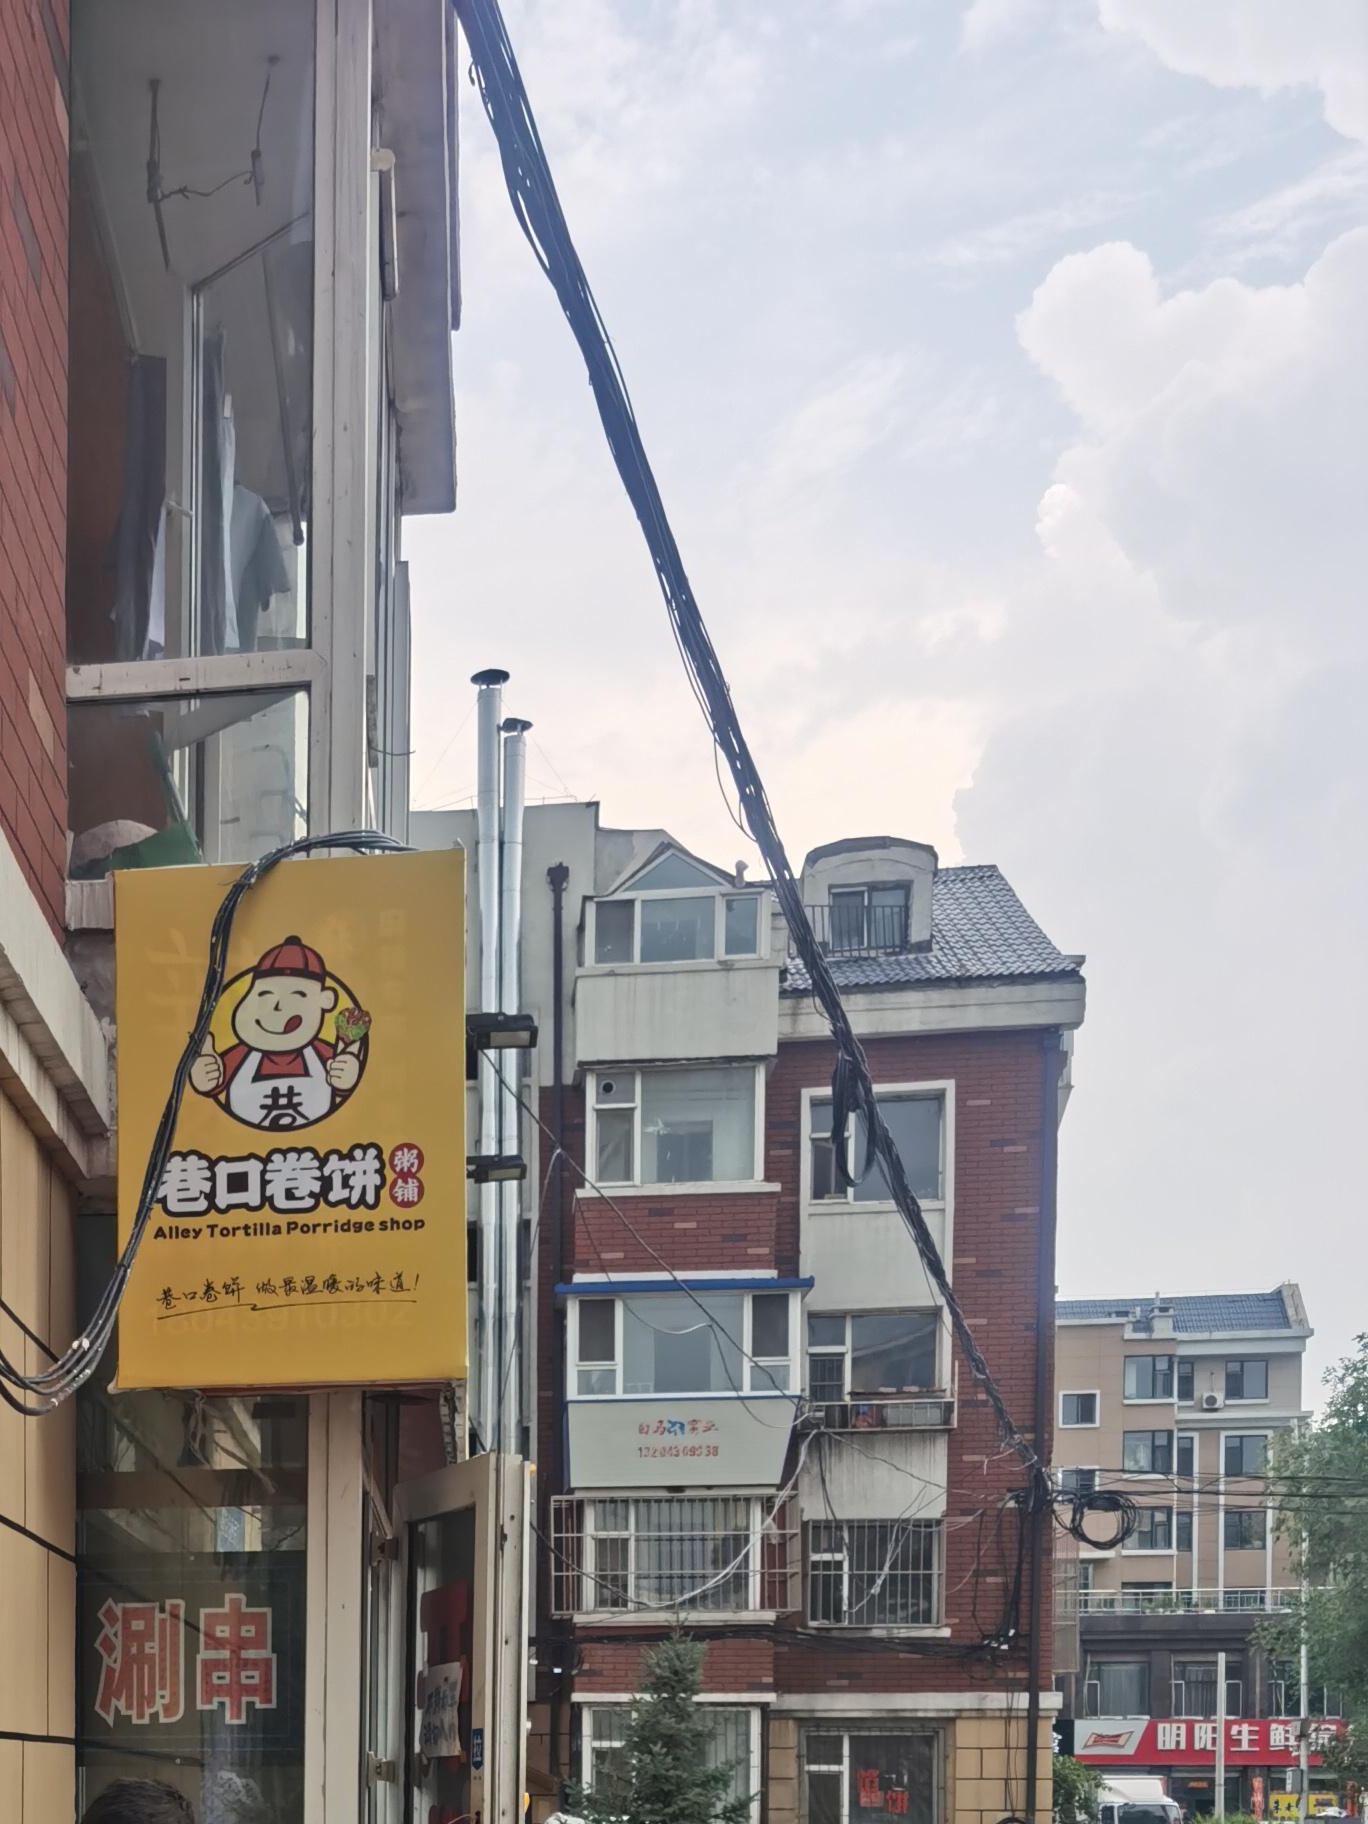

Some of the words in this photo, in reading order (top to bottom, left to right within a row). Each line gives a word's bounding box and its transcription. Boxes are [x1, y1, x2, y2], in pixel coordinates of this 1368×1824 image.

[156, 1145, 384, 1215] 巷口卷饼
[393, 1147, 420, 1203] 粥铺
[153, 1225, 203, 1241] Alley
[207, 1222, 282, 1238] Tortilla
[286, 1219, 375, 1236] Porridge
[378, 1217, 426, 1234] shop
[94, 1593, 277, 1727] 涮串
